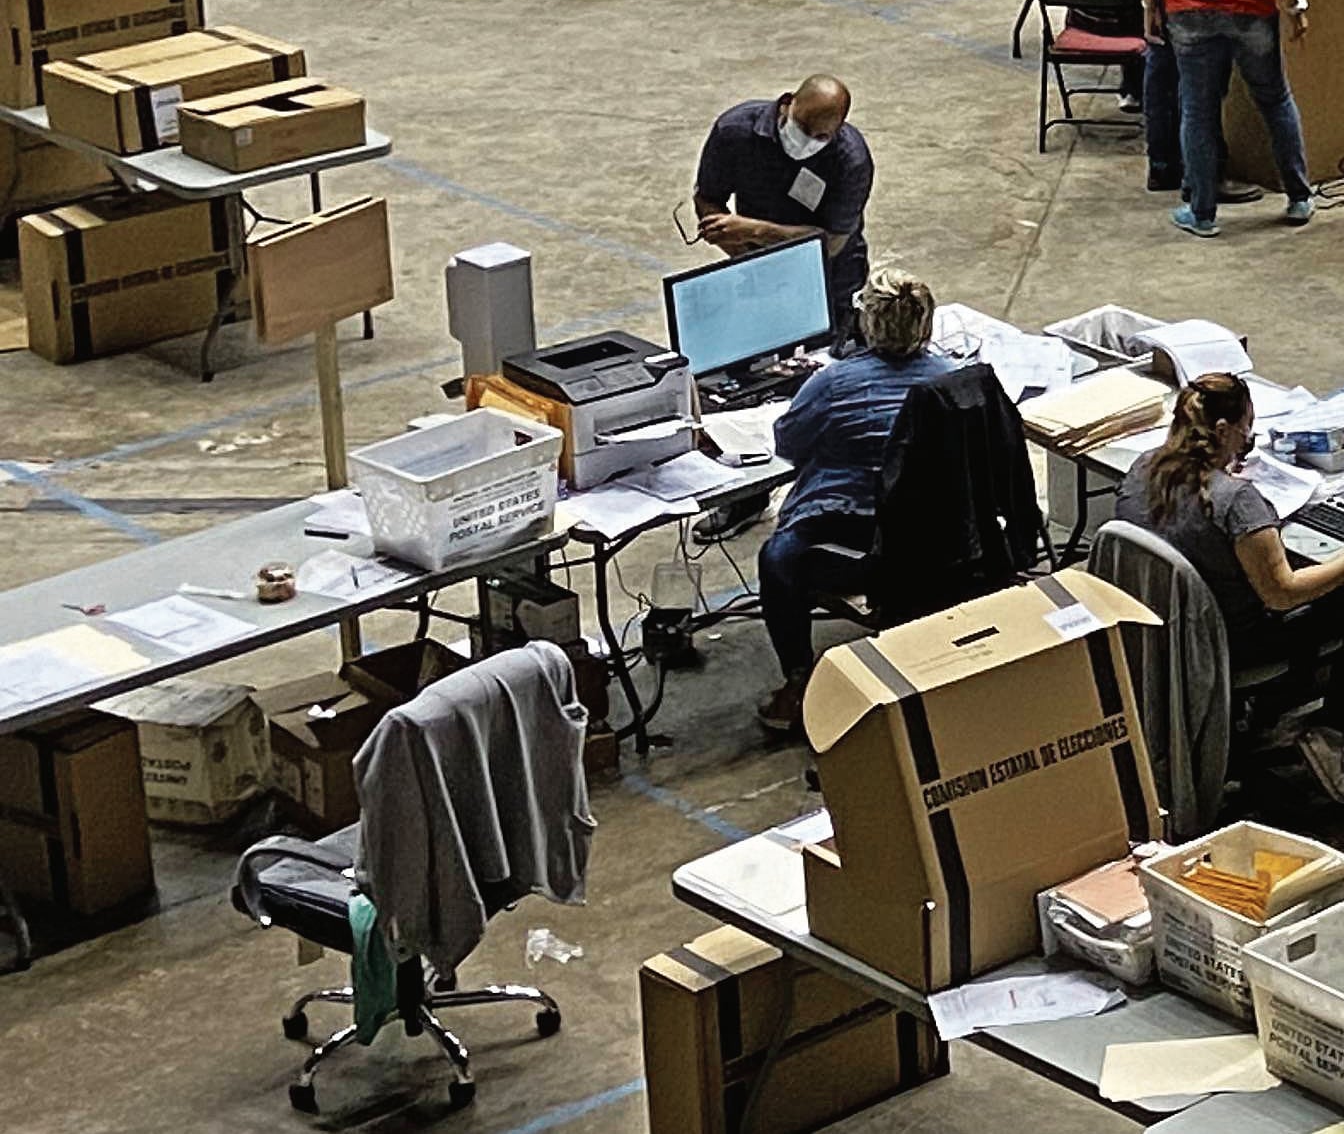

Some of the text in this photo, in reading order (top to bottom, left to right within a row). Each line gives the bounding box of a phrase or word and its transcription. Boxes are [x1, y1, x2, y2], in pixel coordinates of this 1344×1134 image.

[449, 520, 497, 543] POSTAL
[499, 500, 545, 525] SERVICE
[453, 505, 496, 528] UNITED
[498, 488, 540, 511] STATES
[989, 750, 1041, 786] ESTATAL
[1040, 742, 1058, 767] DE
[1057, 717, 1128, 761] ELECCIONES
[1203, 953, 1245, 983] STATES
[1269, 1031, 1312, 1069] POSTAL
[1270, 1018, 1313, 1048] UNITED
